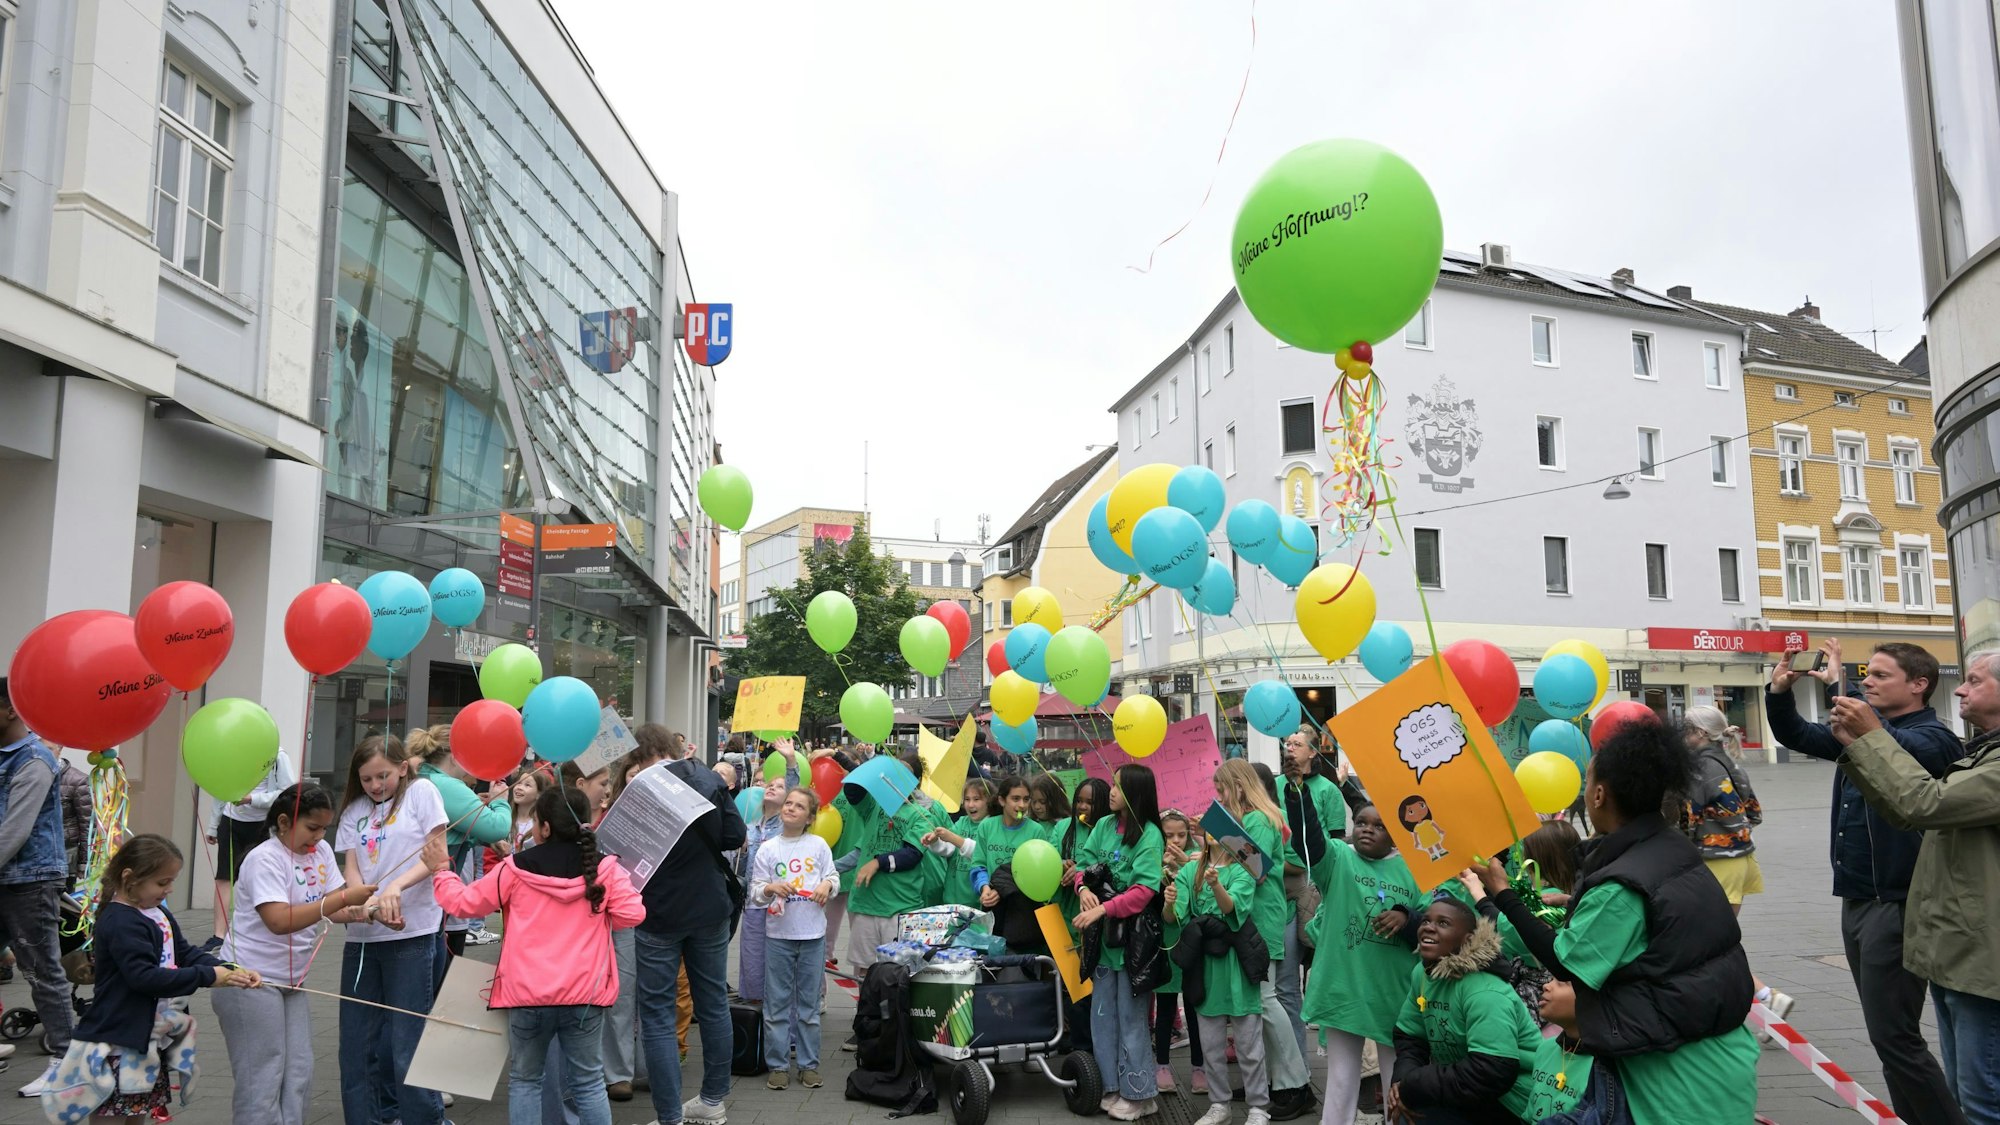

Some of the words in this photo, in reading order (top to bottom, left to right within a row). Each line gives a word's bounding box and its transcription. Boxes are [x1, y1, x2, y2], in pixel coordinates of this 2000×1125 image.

[1238, 237, 1270, 274] Meine
[1172, 541, 1200, 566] OGS!?
[373, 607, 397, 618] Meine
[165, 632, 194, 645] Meine
[98, 680, 141, 700] Meine
[1410, 714, 1436, 733] OGS
[1418, 729, 1438, 743] muss
[988, 844, 1003, 852] OGS
[294, 863, 327, 887] OGS
[775, 857, 815, 878] OGS
